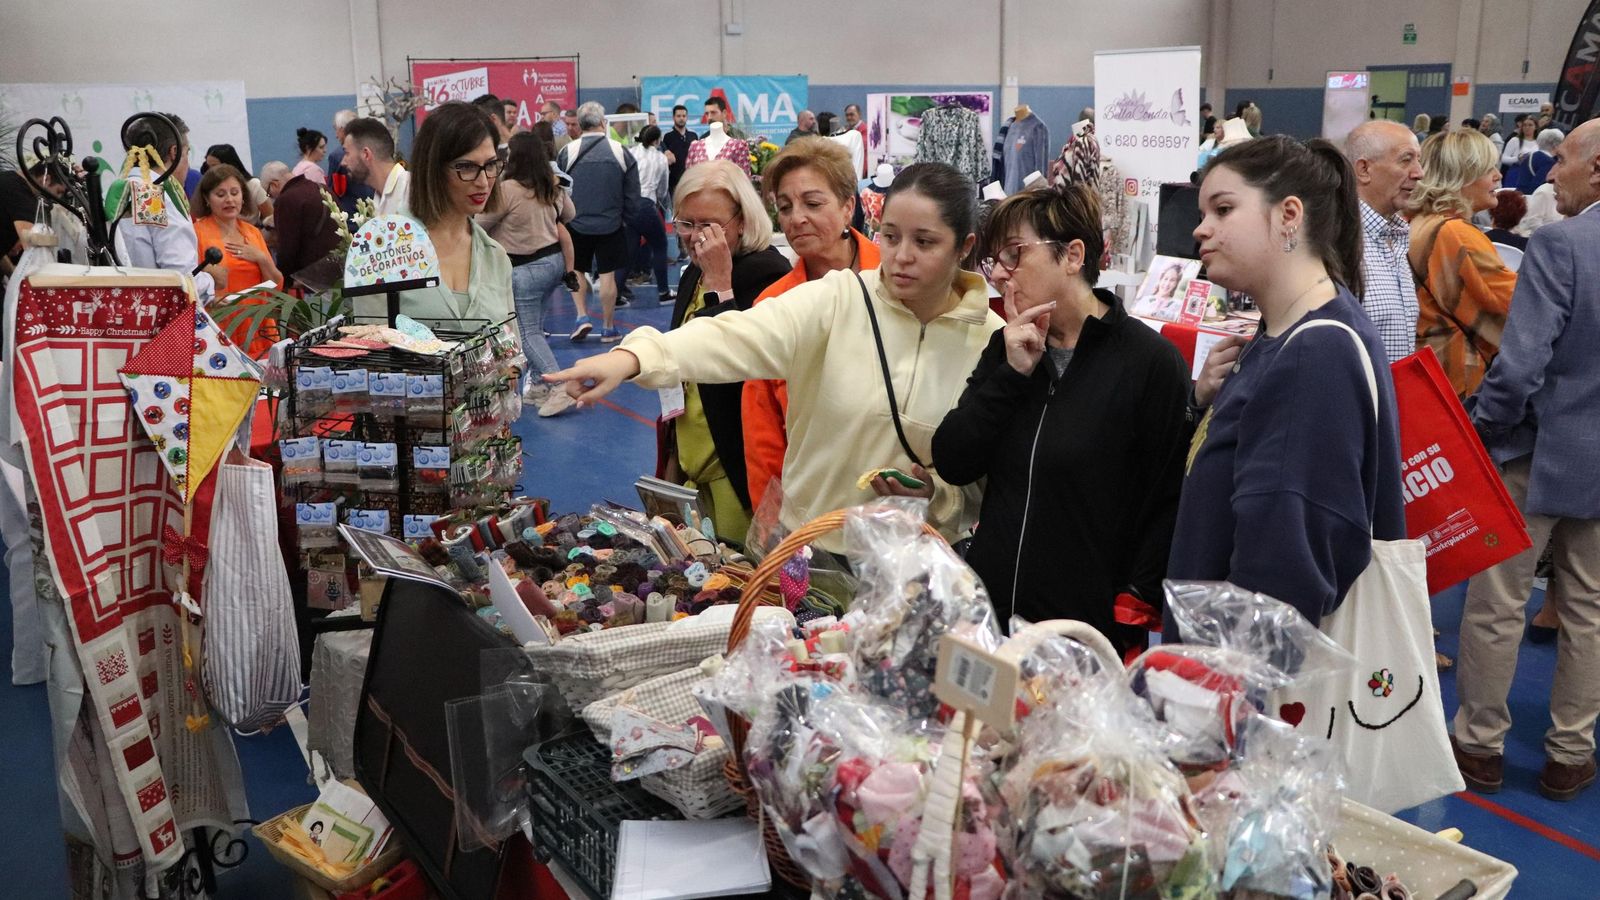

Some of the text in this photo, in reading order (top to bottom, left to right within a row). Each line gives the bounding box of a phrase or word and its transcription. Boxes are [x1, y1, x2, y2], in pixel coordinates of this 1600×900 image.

[451, 76, 485, 93] OCTUBRE
[541, 84, 567, 92] ECAMA
[431, 84, 449, 104] 16
[1508, 97, 1539, 105] ECAMA
[651, 88, 798, 126] ECAMA
[1115, 135, 1190, 148] 620 869597
[370, 244, 412, 264] BOTONES
[360, 250, 425, 277] DECORATIVOS
[80, 327, 150, 336] Happy Christmas!
[1408, 443, 1440, 466] con su
